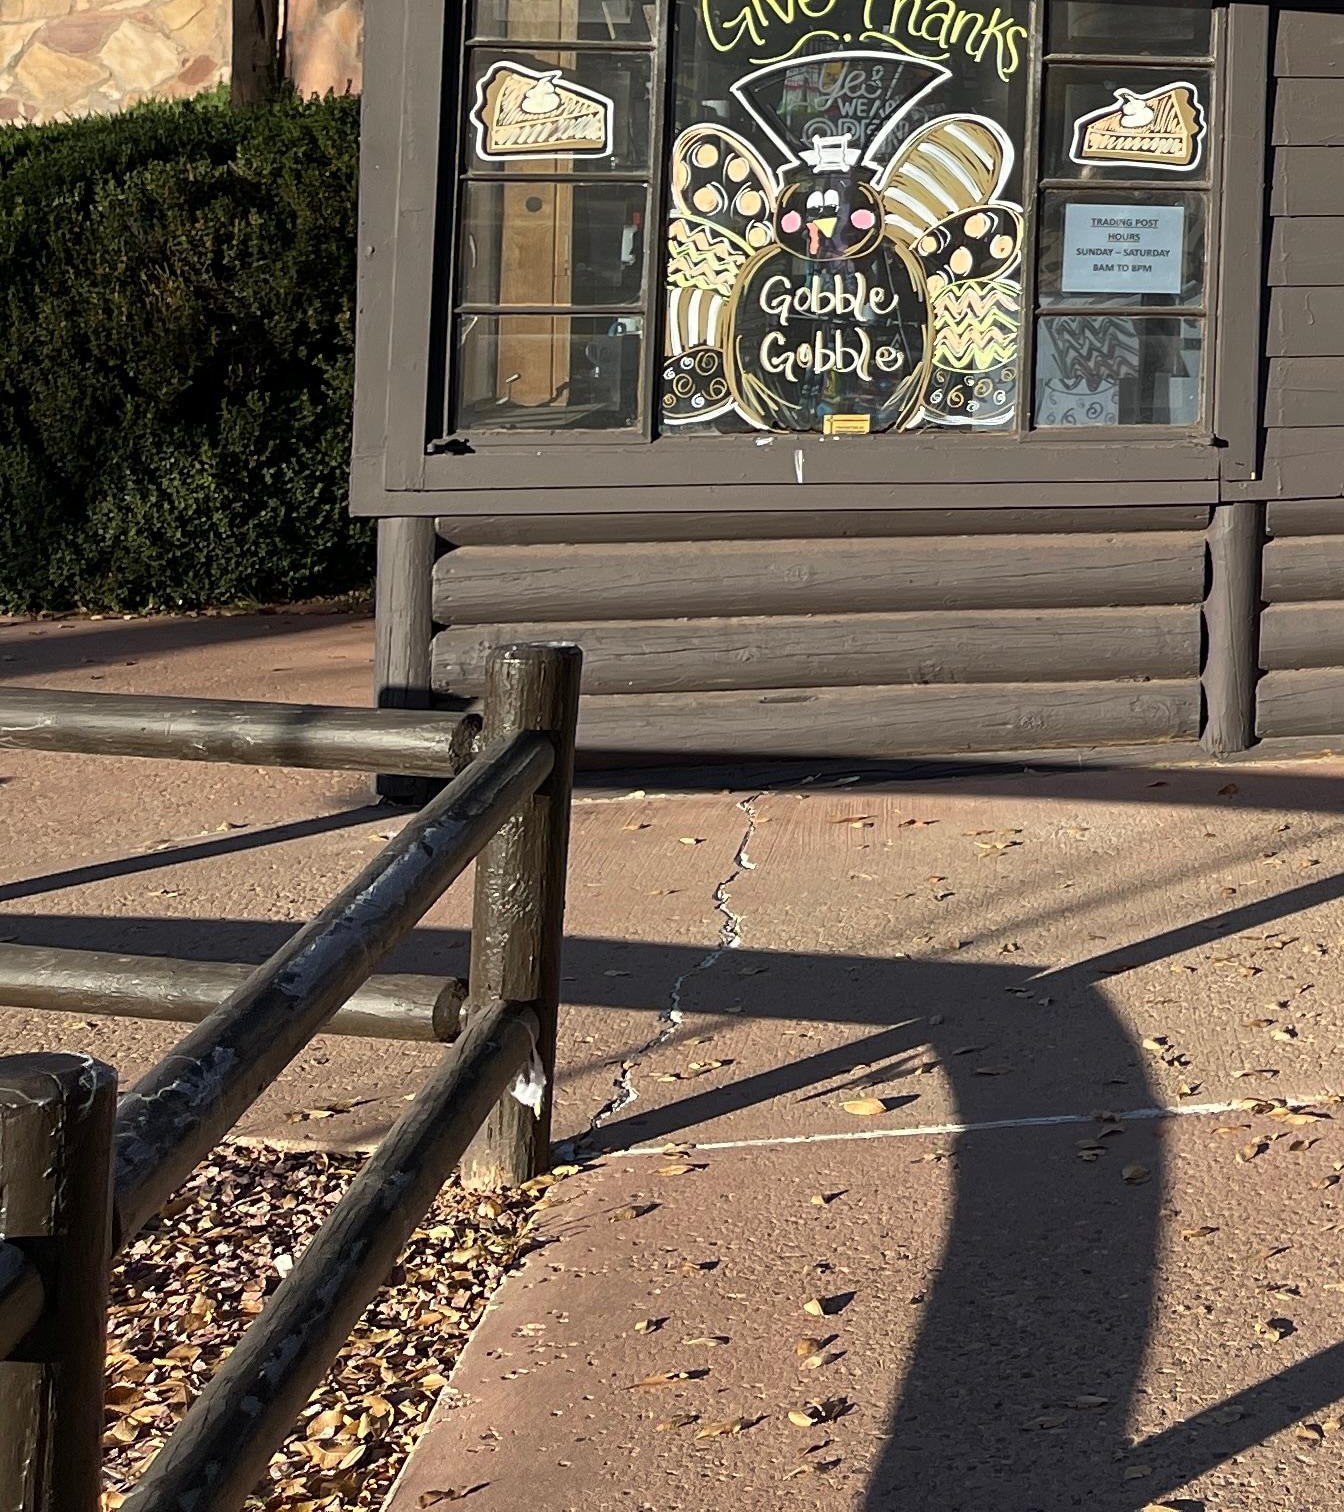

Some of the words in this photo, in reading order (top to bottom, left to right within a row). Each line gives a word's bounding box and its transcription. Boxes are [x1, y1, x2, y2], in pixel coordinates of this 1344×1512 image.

[837, 98, 867, 117] WE
[1091, 217, 1133, 227] TRADING
[1135, 218, 1160, 228] POST
[1107, 232, 1141, 241] HOURS
[1075, 247, 1114, 256] SUNDAY
[1122, 248, 1171, 257] SATURDAY
[1092, 263, 1115, 272] 8AM
[1116, 264, 1130, 273] TO
[1131, 264, 1153, 273] 8PM
[759, 271, 900, 326] Gobble
[759, 326, 905, 383] Gobble
